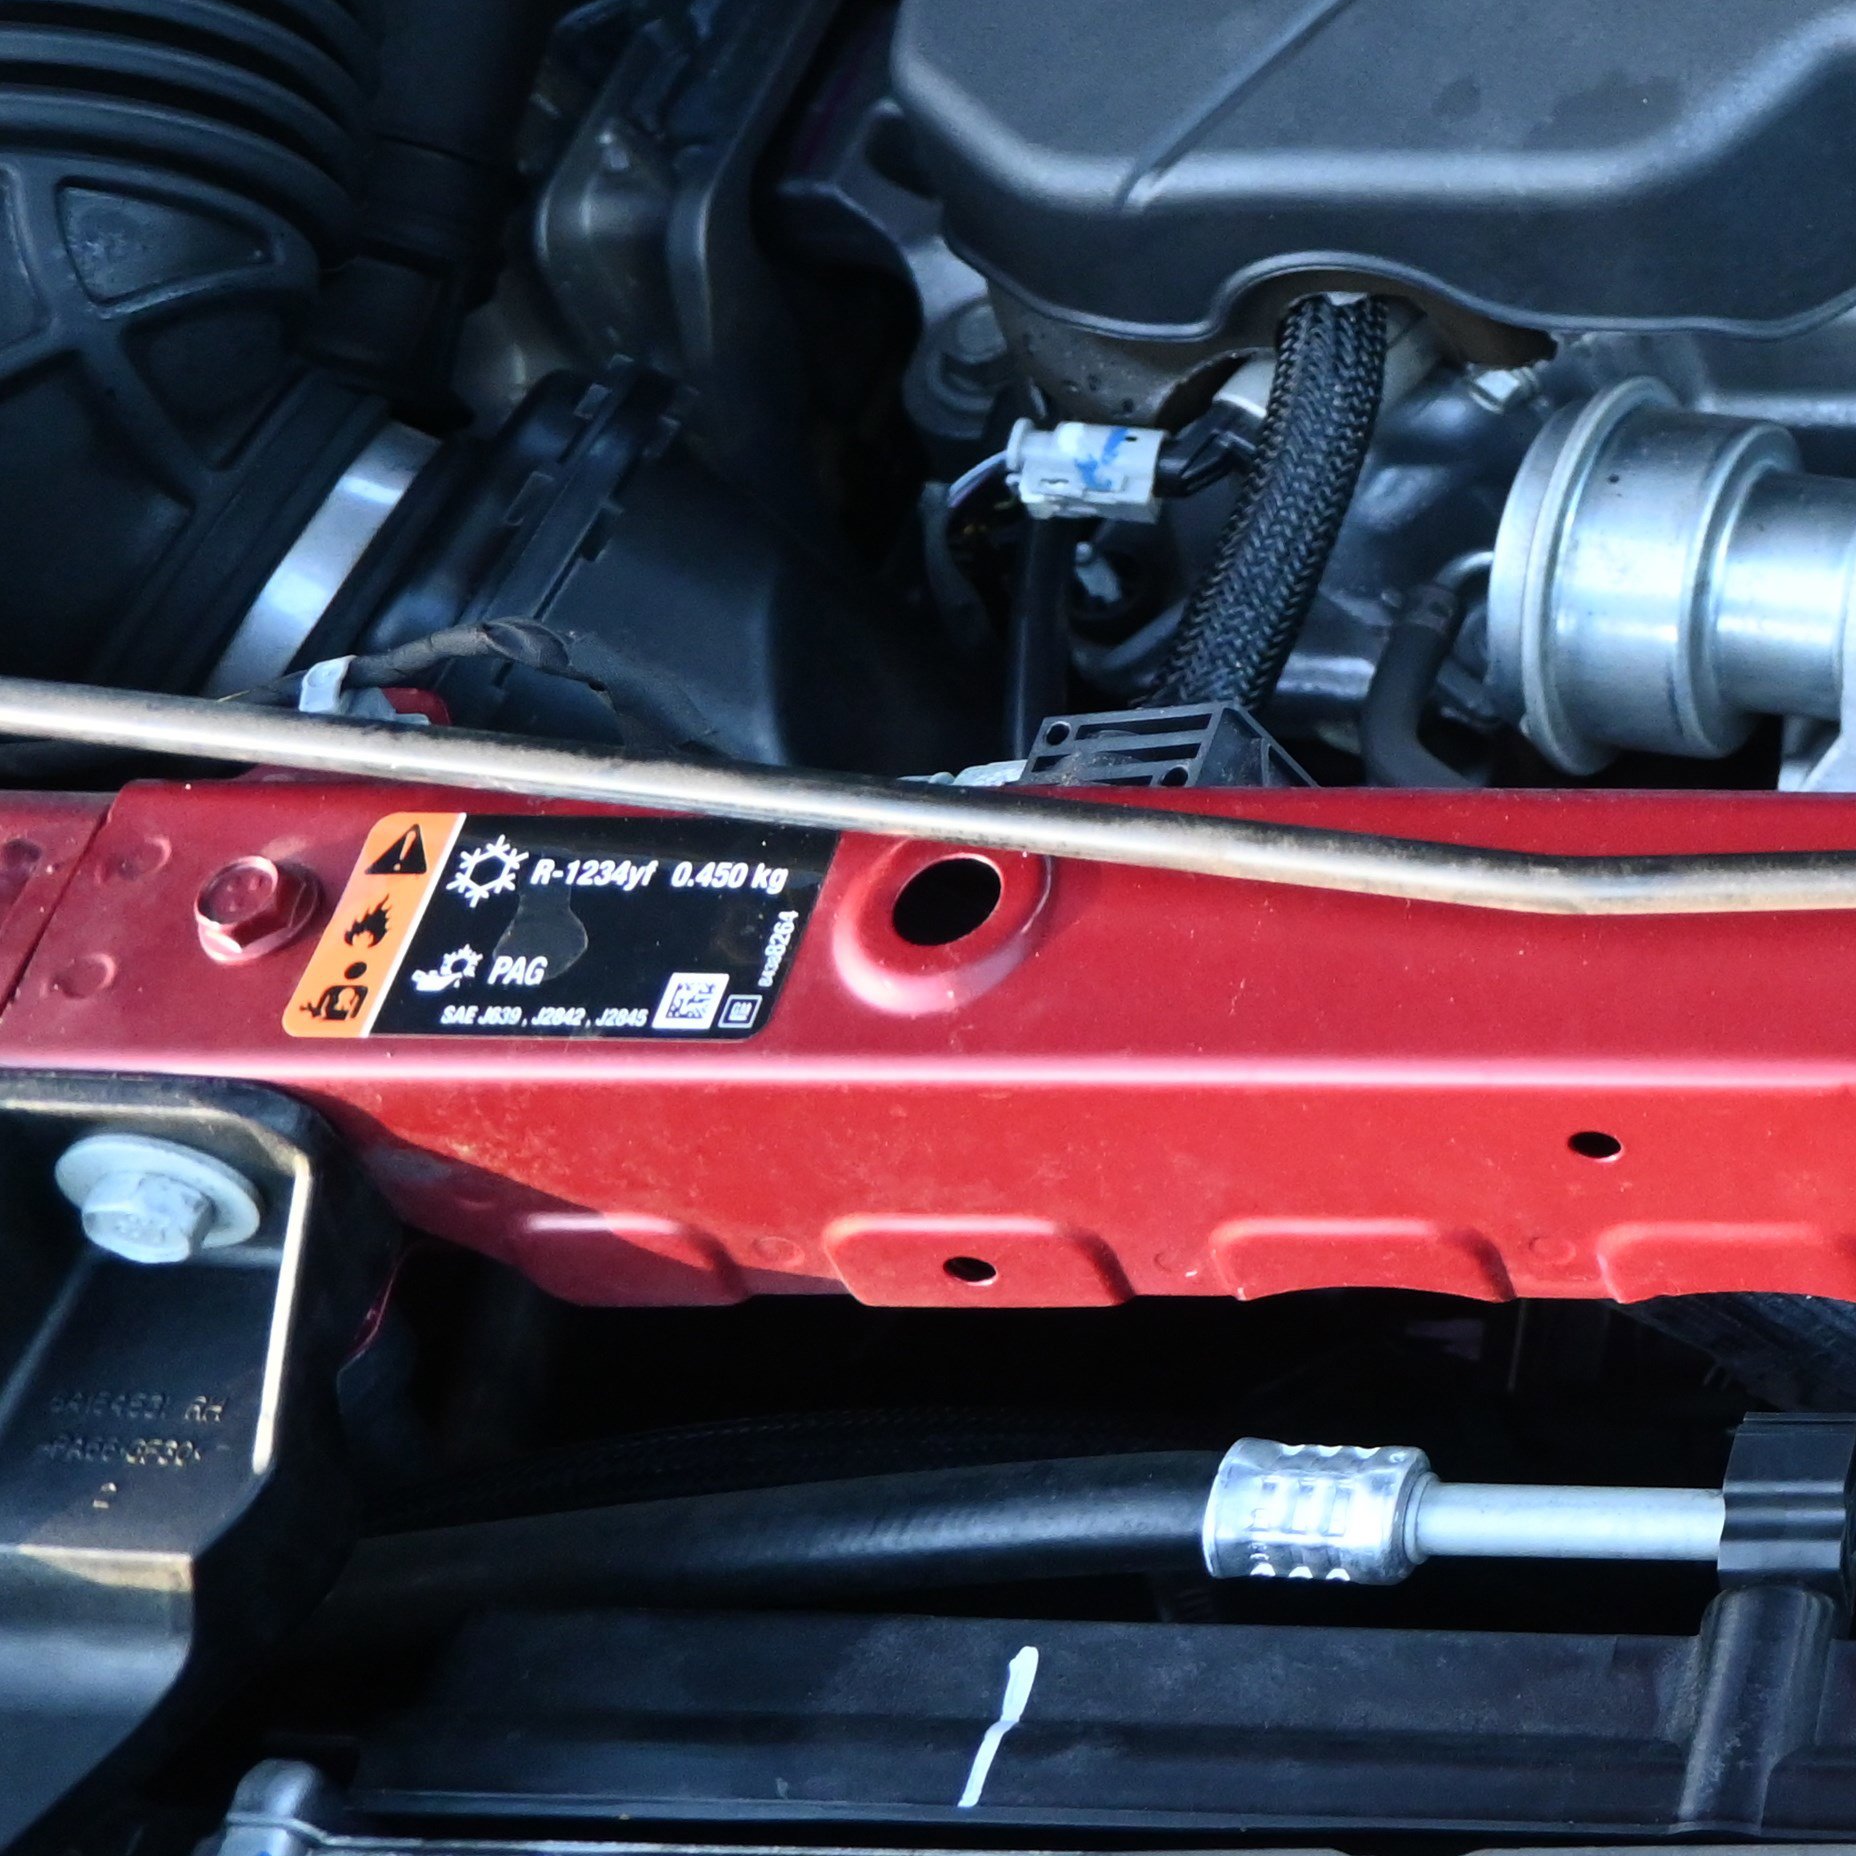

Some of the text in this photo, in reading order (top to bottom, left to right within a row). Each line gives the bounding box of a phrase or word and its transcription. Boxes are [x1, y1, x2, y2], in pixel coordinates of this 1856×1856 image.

[530, 858, 790, 895] R-1234yf 0.450 kg
[487, 956, 548, 986] PAG
[440, 1005, 479, 1025] SAE
